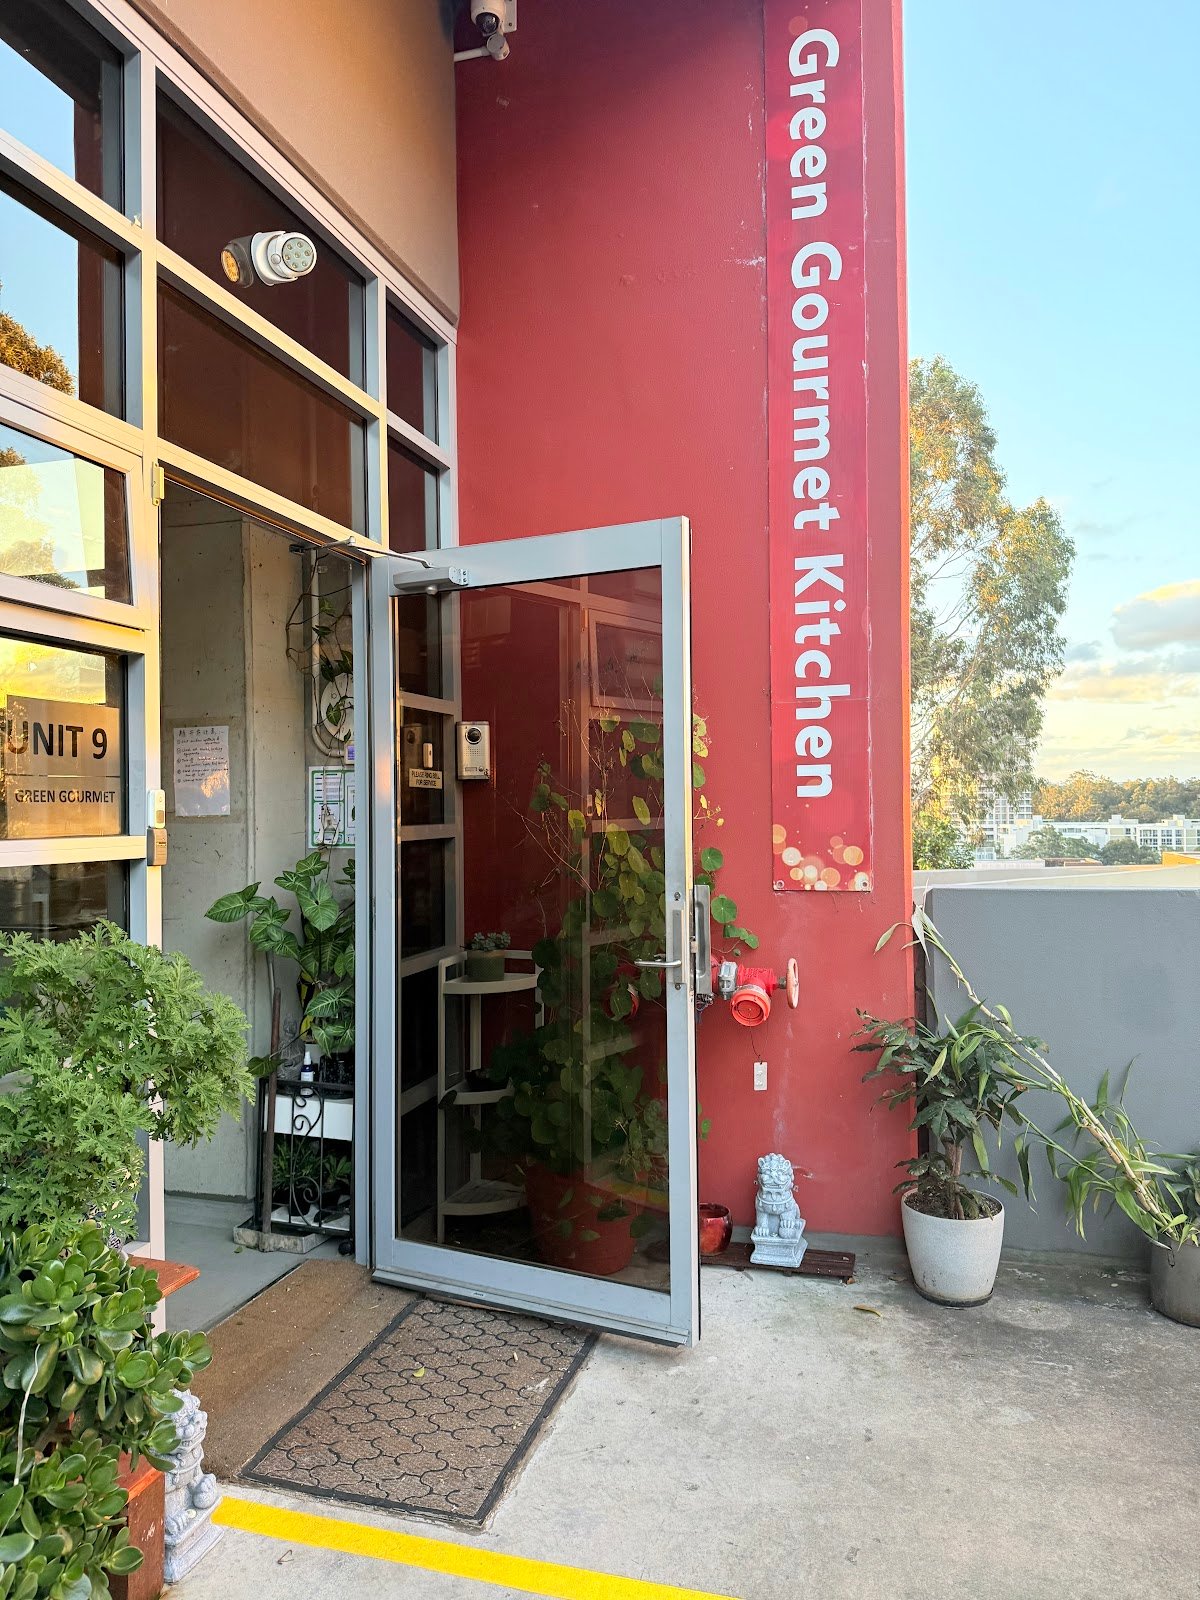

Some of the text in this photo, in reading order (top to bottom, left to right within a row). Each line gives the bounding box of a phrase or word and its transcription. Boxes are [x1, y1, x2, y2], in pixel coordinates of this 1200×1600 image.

[789, 28, 850, 798] Green Gourmet Kitchen
[7, 719, 108, 760] UNIT 9
[412, 770, 424, 778] PLEASE
[423, 779, 436, 787] SERVICE
[15, 789, 115, 804] GREEN GOURMET
